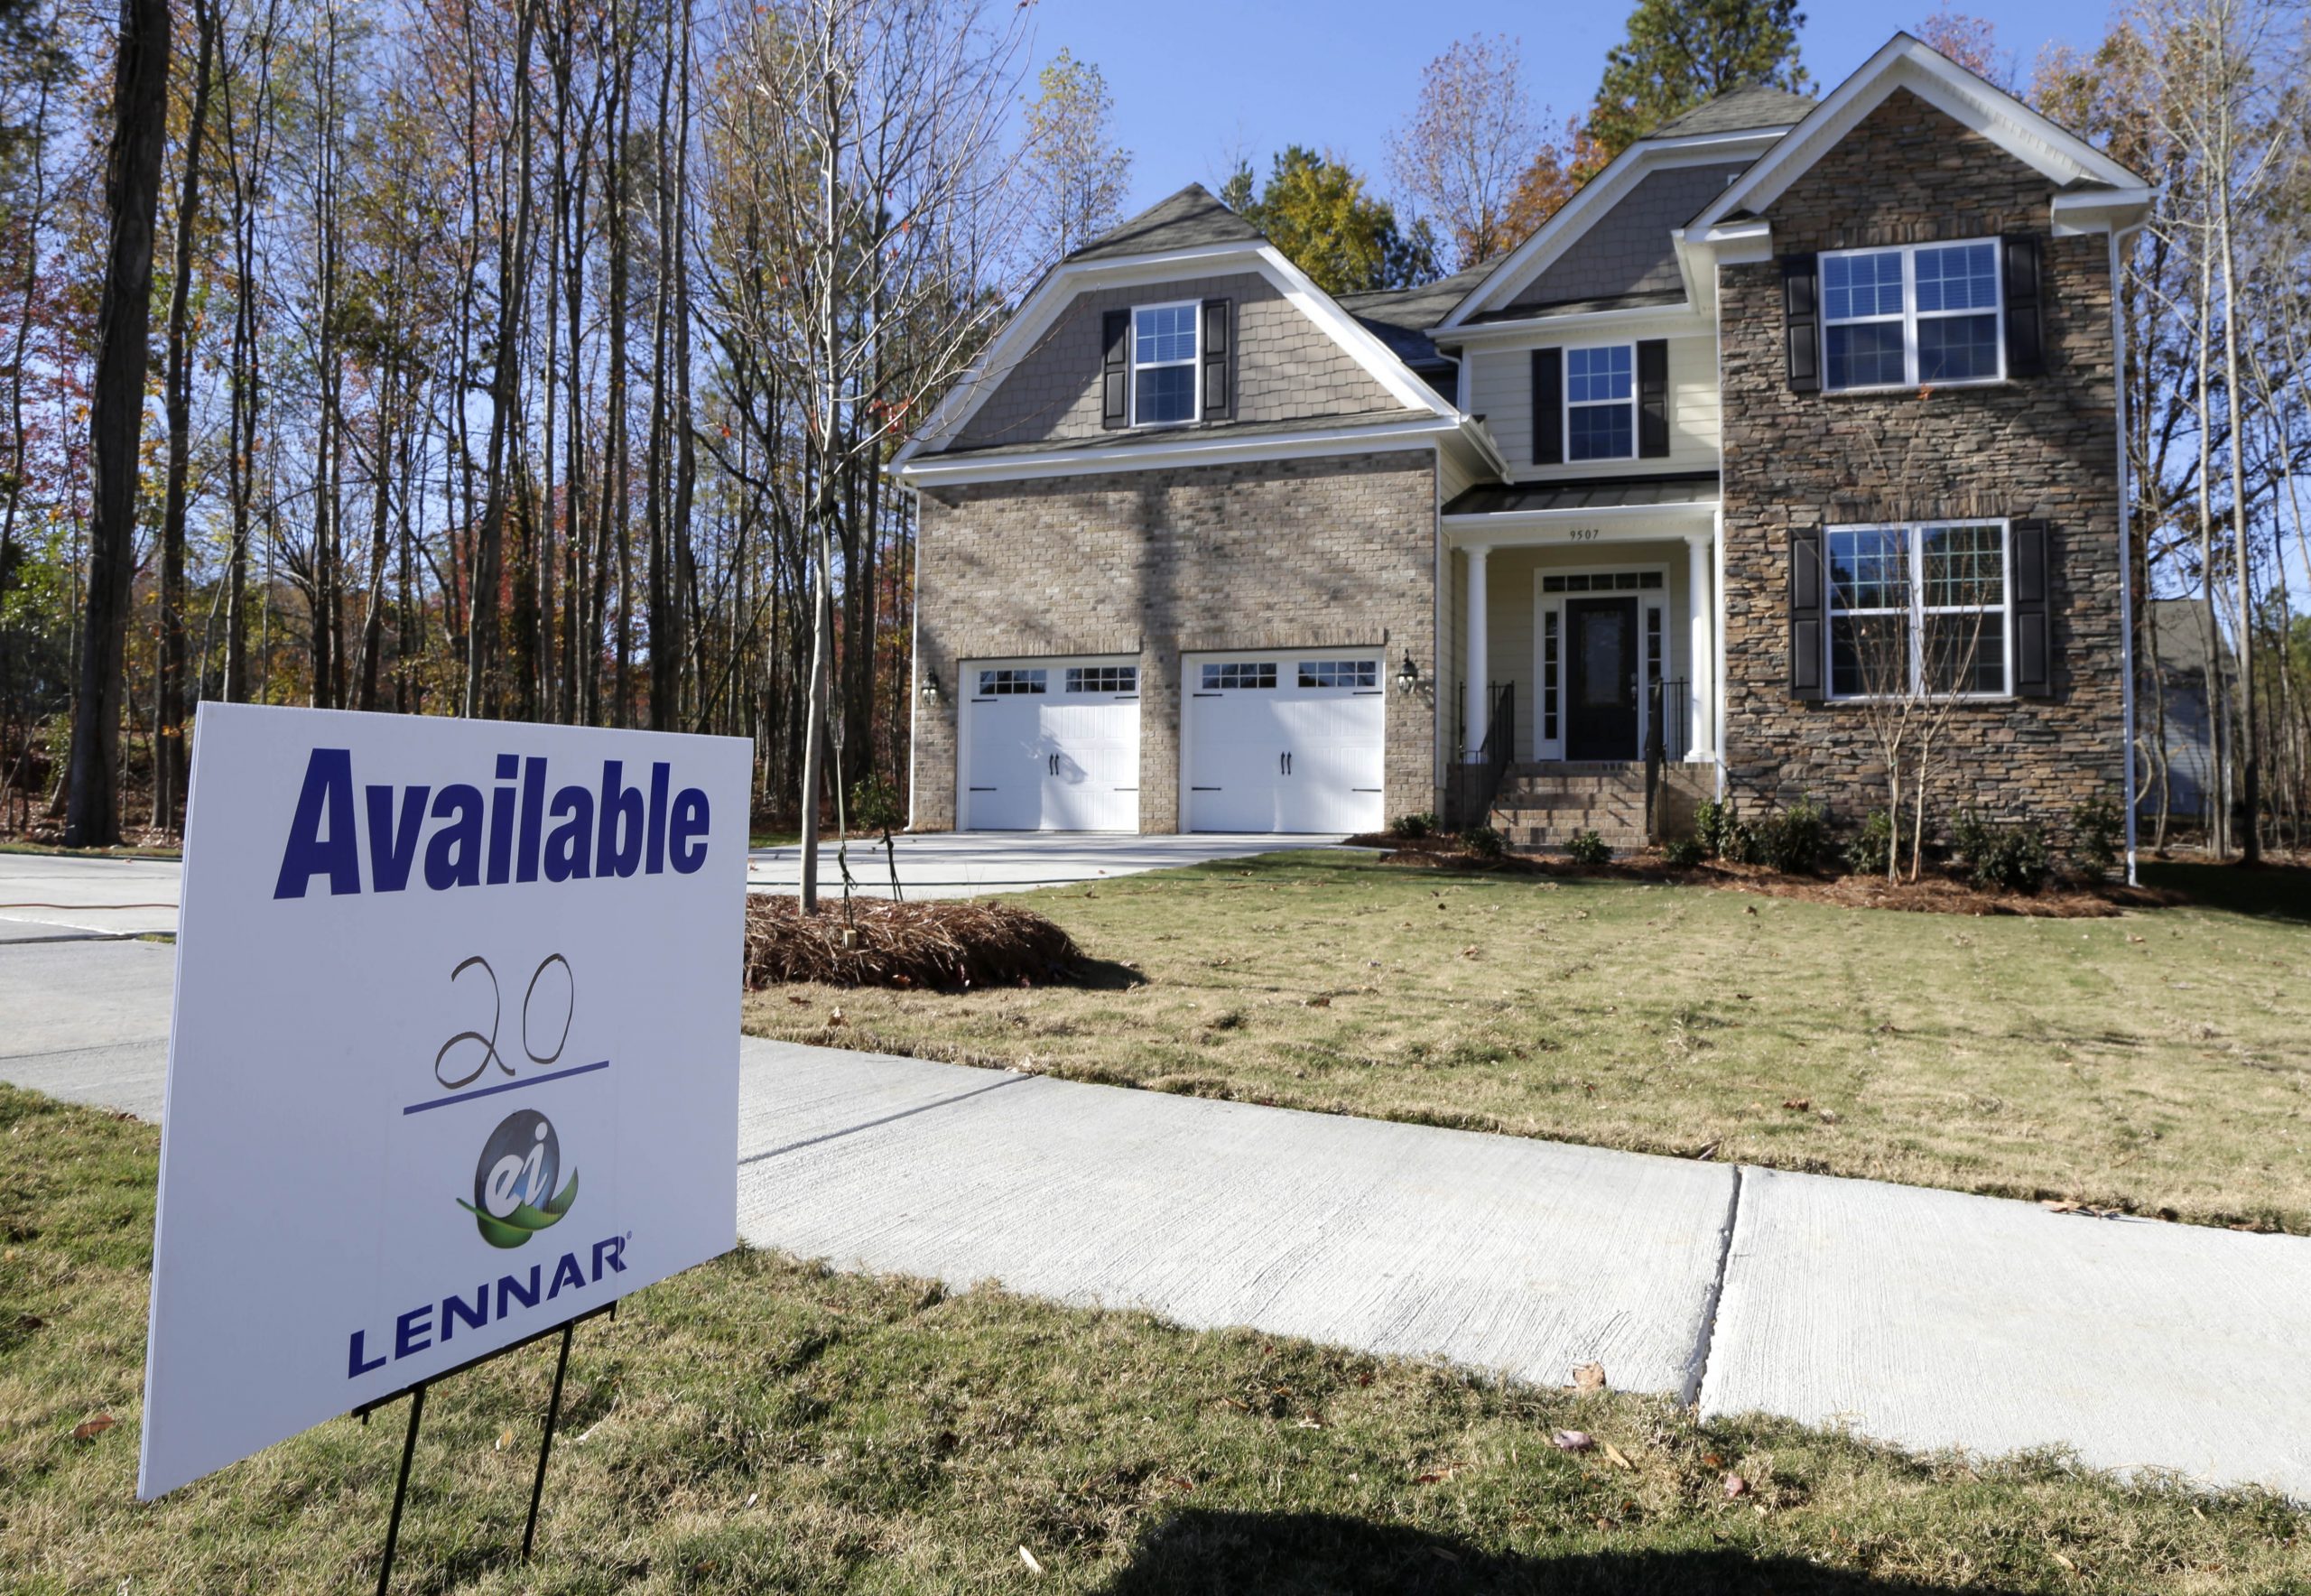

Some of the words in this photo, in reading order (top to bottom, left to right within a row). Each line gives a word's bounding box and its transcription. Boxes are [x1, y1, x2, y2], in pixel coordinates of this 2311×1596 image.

[1570, 529, 1599, 540] 9507
[274, 747, 710, 899] Available
[435, 952, 574, 1090] 20
[348, 1235, 627, 1380] LENNAR
